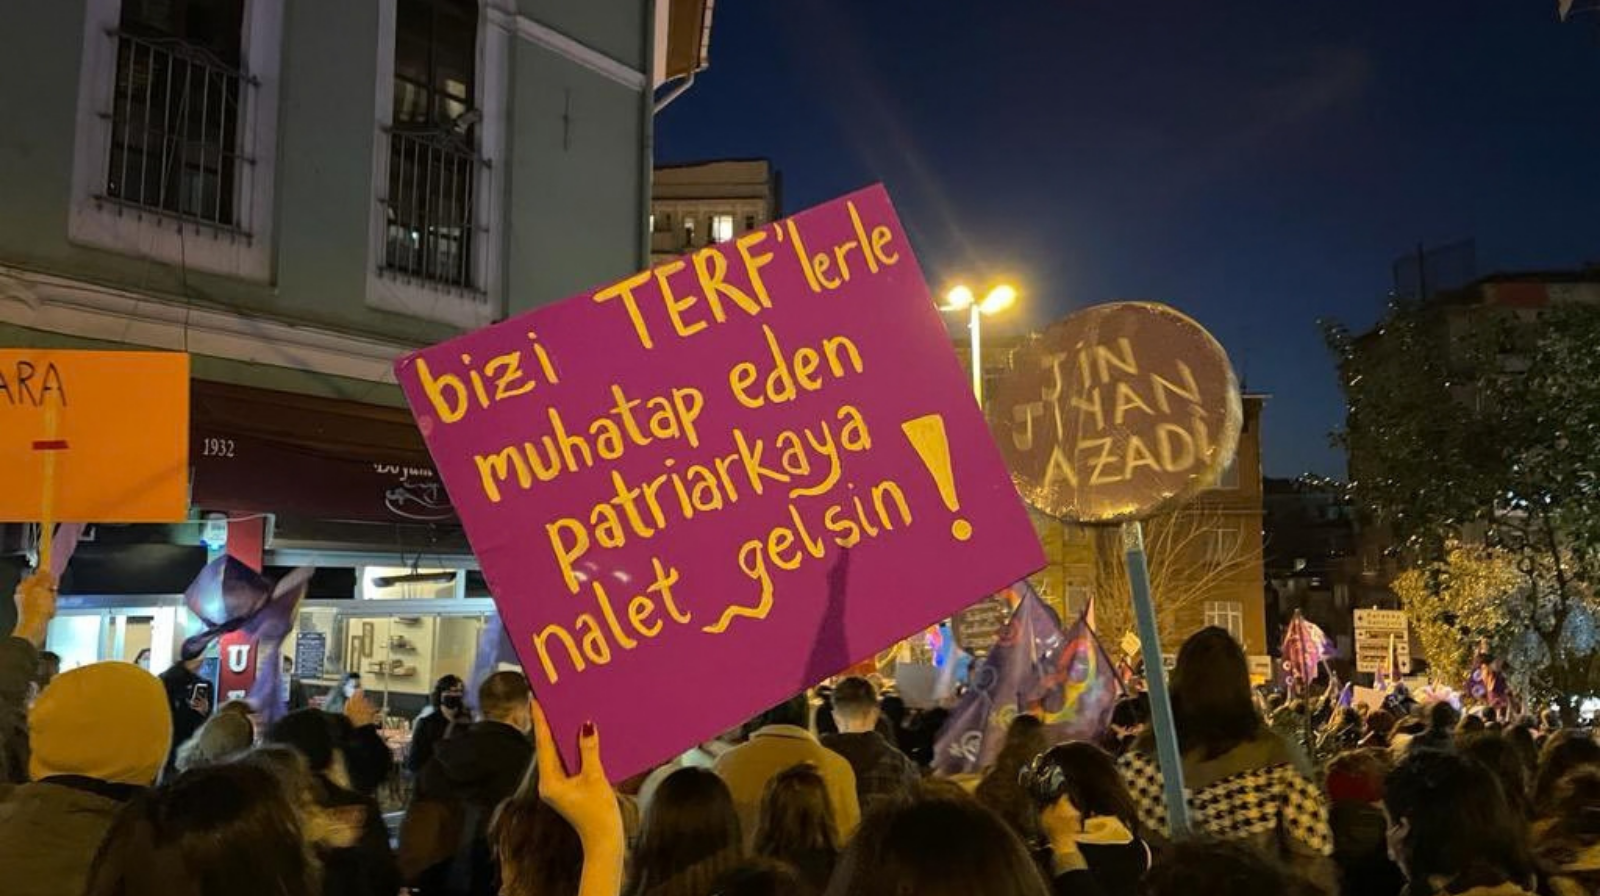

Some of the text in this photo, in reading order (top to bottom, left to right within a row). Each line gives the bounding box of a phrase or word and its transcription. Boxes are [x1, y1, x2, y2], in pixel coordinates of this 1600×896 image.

[416, 201, 899, 424] bizi TERF'lerle
[202, 437, 235, 458] 1932
[474, 325, 864, 502] muhatap eden
[546, 404, 872, 594] patriarkaya
[532, 558, 692, 684] nalet
[702, 479, 913, 634] gelsin
